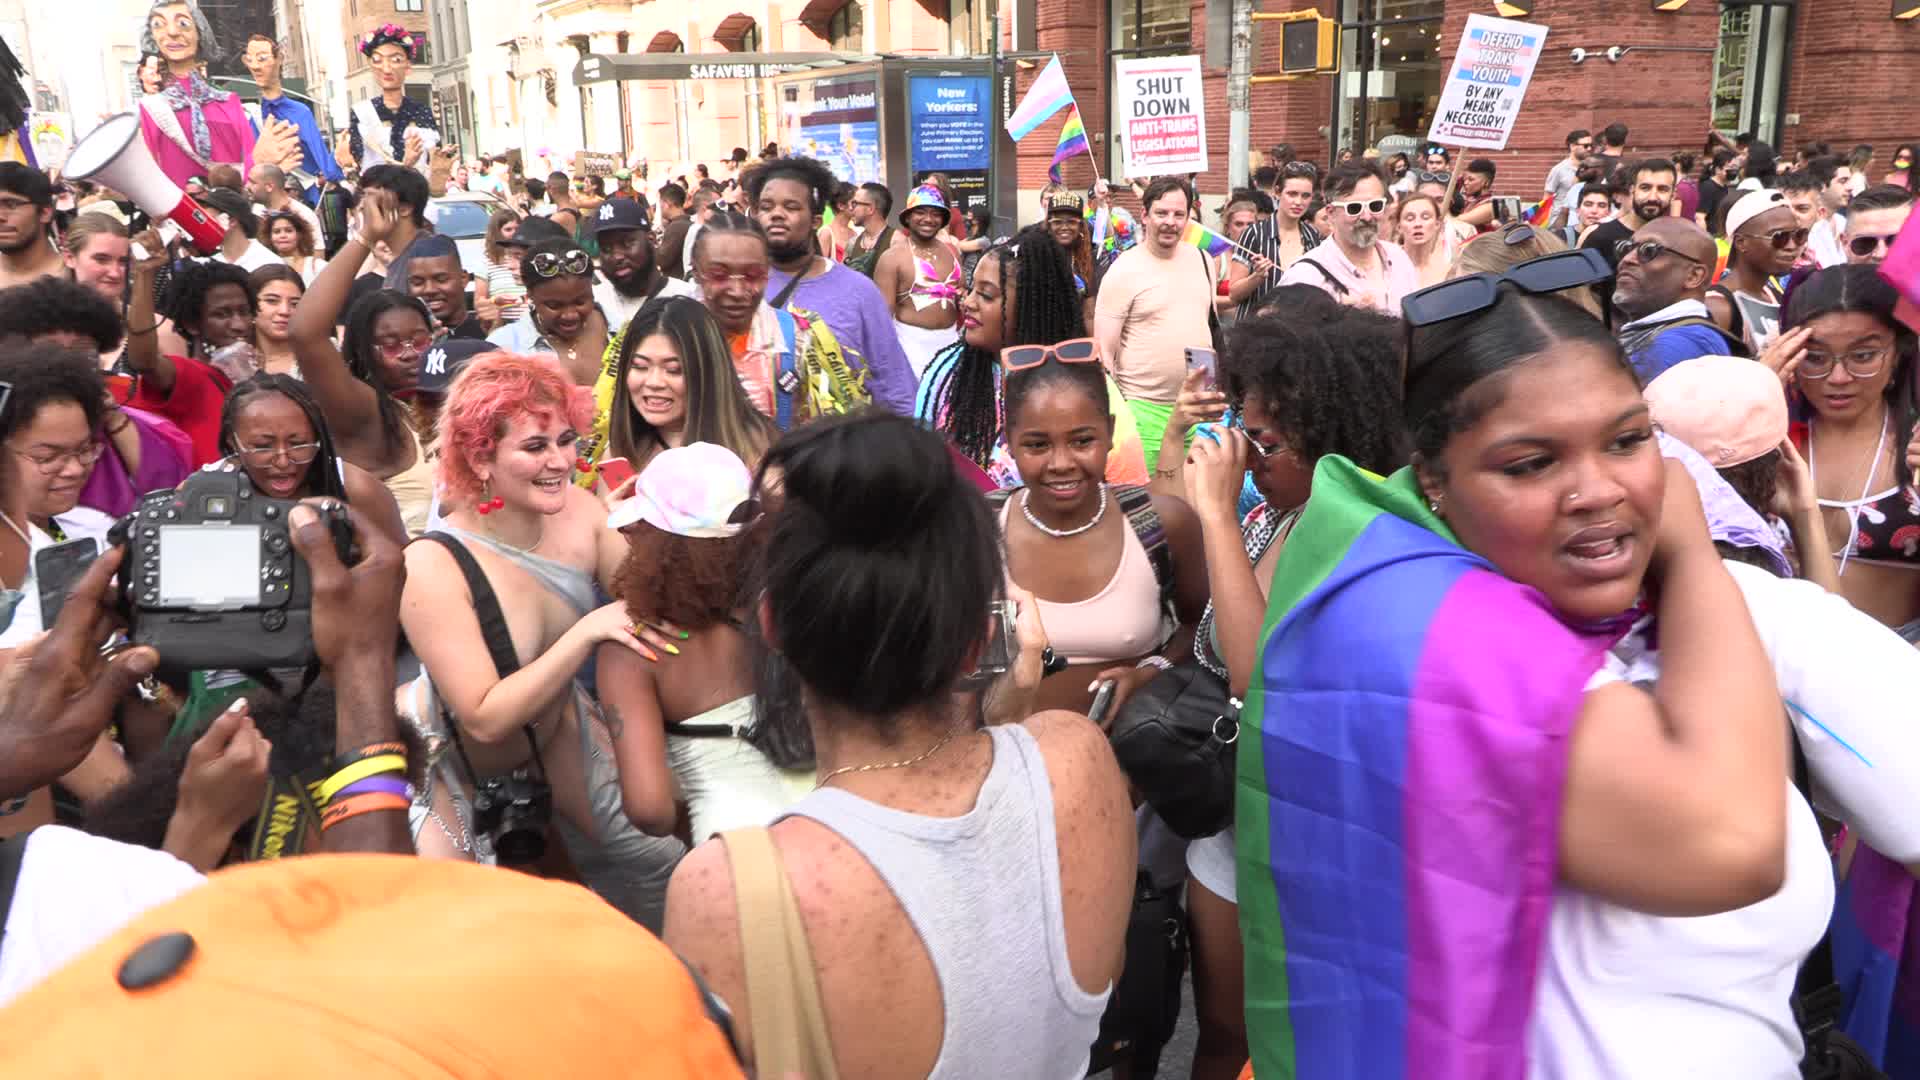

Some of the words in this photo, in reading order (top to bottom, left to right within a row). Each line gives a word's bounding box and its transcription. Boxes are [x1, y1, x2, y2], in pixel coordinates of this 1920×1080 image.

[1478, 31, 1524, 49] DEFEND
[1478, 48, 1516, 66] TRANS
[689, 63, 755, 79] SAFAVIEH
[1471, 65, 1512, 84] YOUTH
[937, 87, 967, 99] New
[1135, 76, 1184, 96] SHUT
[1465, 84, 1483, 98] BY
[1483, 87, 1504, 100] ANY
[925, 101, 979, 113] Yorkers:
[1133, 97, 1190, 117] DOWN
[1463, 99, 1497, 113] MEANS
[1131, 118, 1198, 136] ANTI-TRANS
[1443, 110, 1507, 129] NECESSARY!
[1132, 135, 1199, 153] LEGISLATION!
[425, 347, 448, 376] NY
